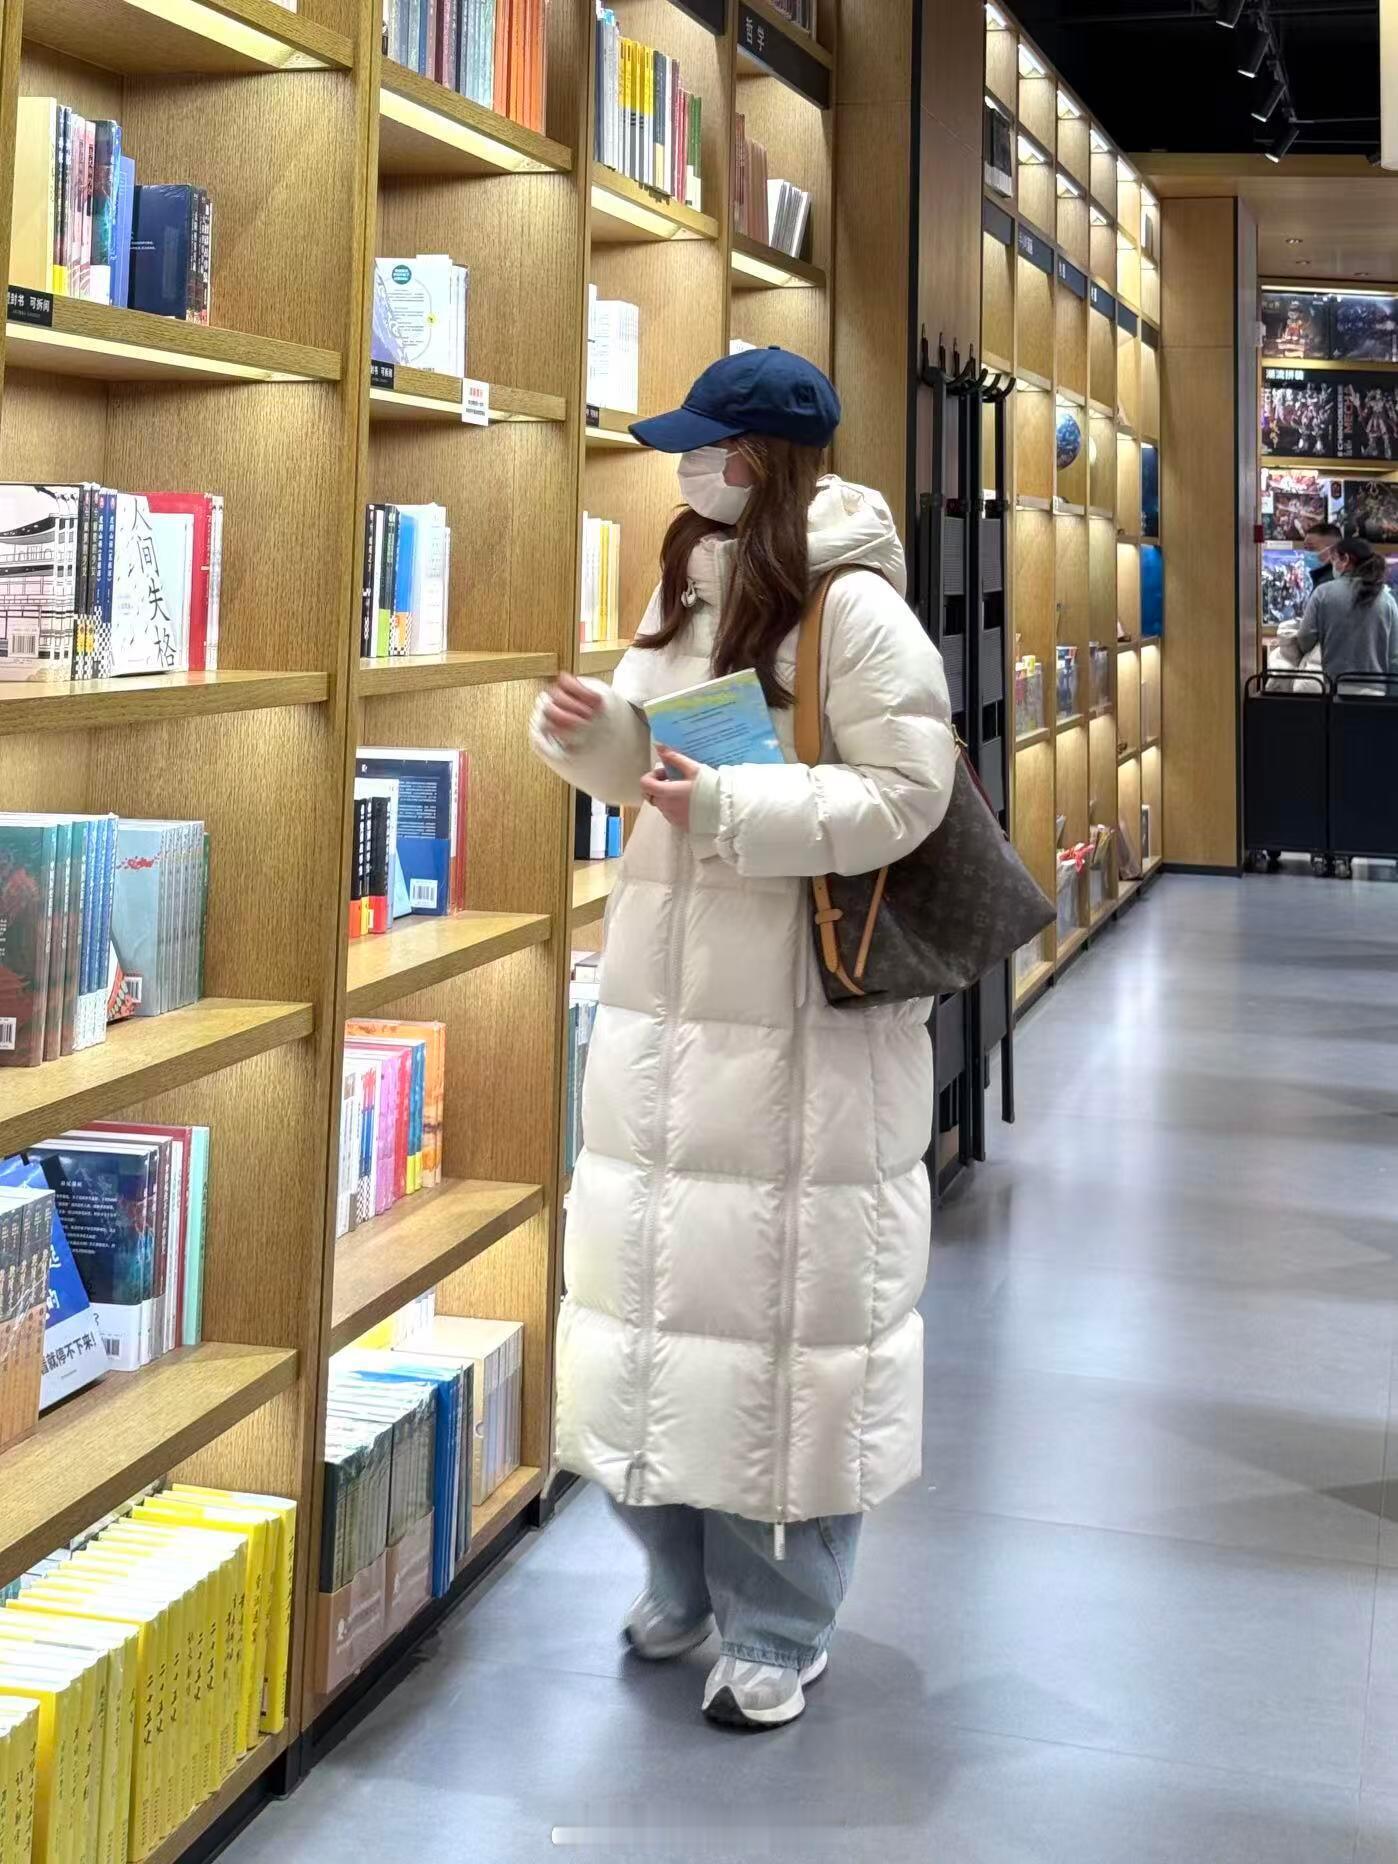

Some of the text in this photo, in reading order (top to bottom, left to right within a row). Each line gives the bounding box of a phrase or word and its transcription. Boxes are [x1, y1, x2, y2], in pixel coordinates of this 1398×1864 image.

[8, 291, 25, 307] 封书
[131, 497, 177, 669] 人间失格
